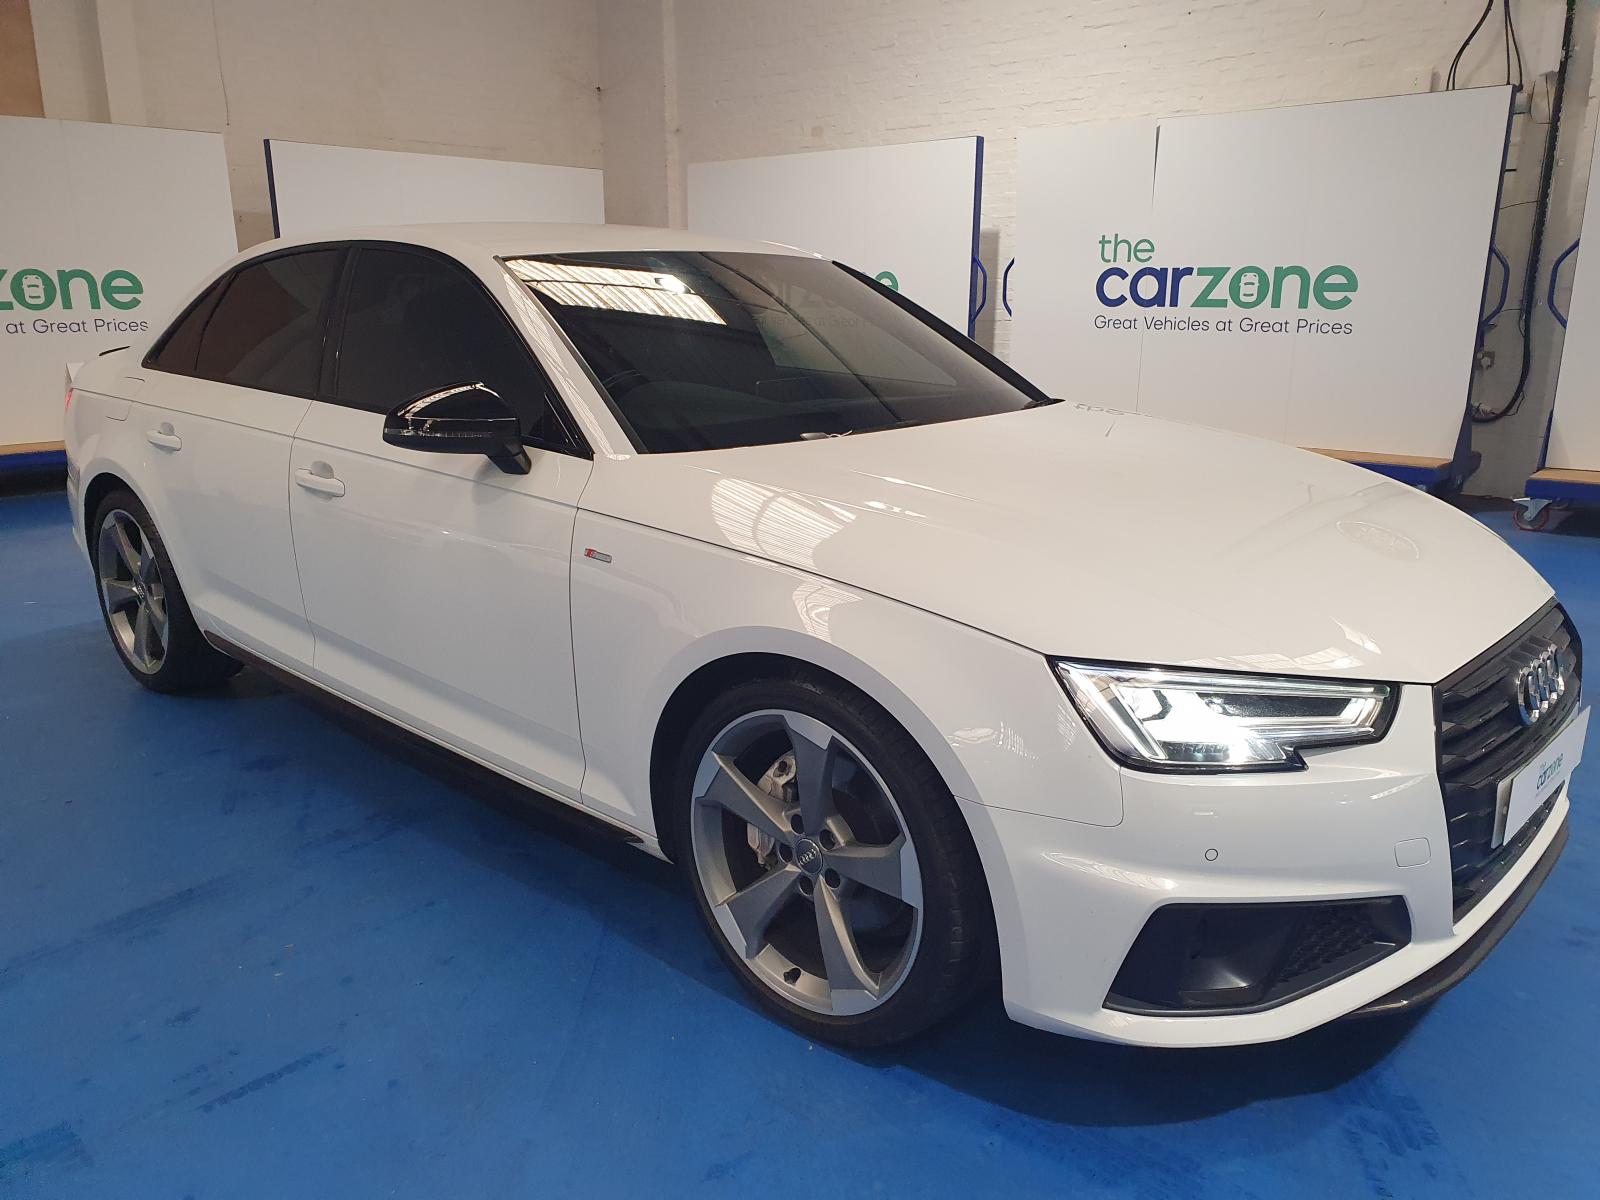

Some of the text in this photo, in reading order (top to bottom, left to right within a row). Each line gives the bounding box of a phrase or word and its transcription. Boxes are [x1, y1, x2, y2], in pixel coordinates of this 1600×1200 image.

[1098, 233, 1155, 263] the
[1095, 264, 1359, 311] carzone
[5, 318, 149, 335] at Great Prices
[1094, 314, 1353, 335] Great Vehicles at Great Prices
